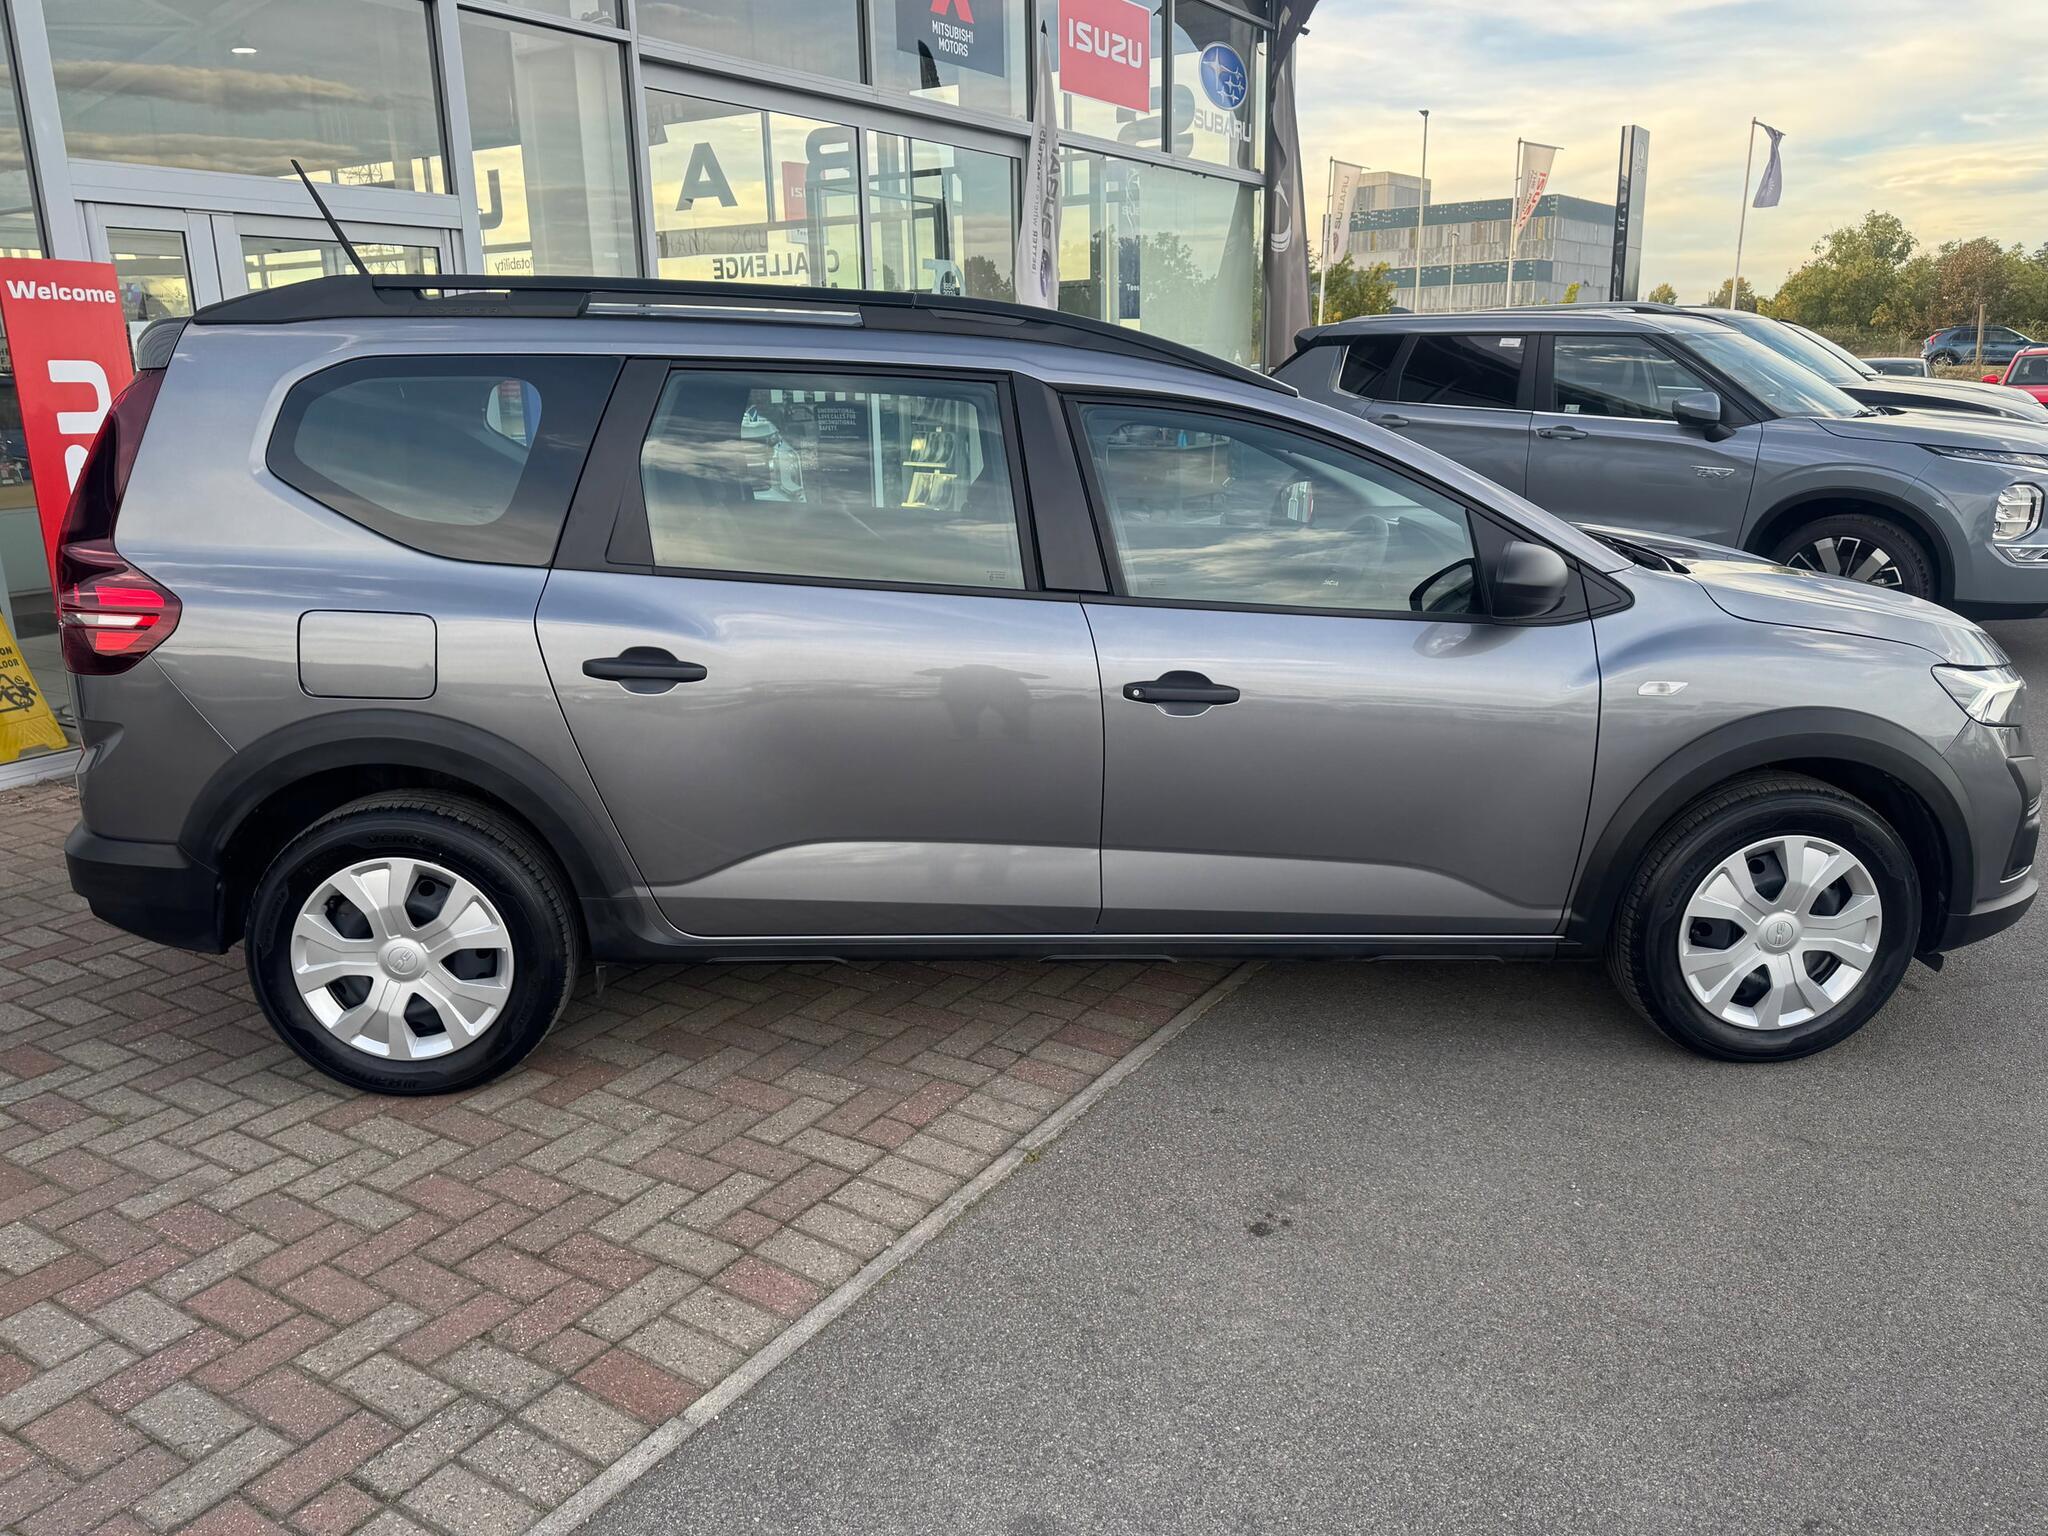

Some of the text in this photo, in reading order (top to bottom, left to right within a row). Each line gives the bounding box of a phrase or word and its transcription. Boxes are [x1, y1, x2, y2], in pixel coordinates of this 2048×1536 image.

[932, 20, 974, 43] MITSUBISHI
[1068, 17, 1142, 69] ISUZU
[938, 38, 969, 57] MOTORS
[1194, 108, 1252, 142] SUBARU
[6, 280, 116, 303] Welcome
